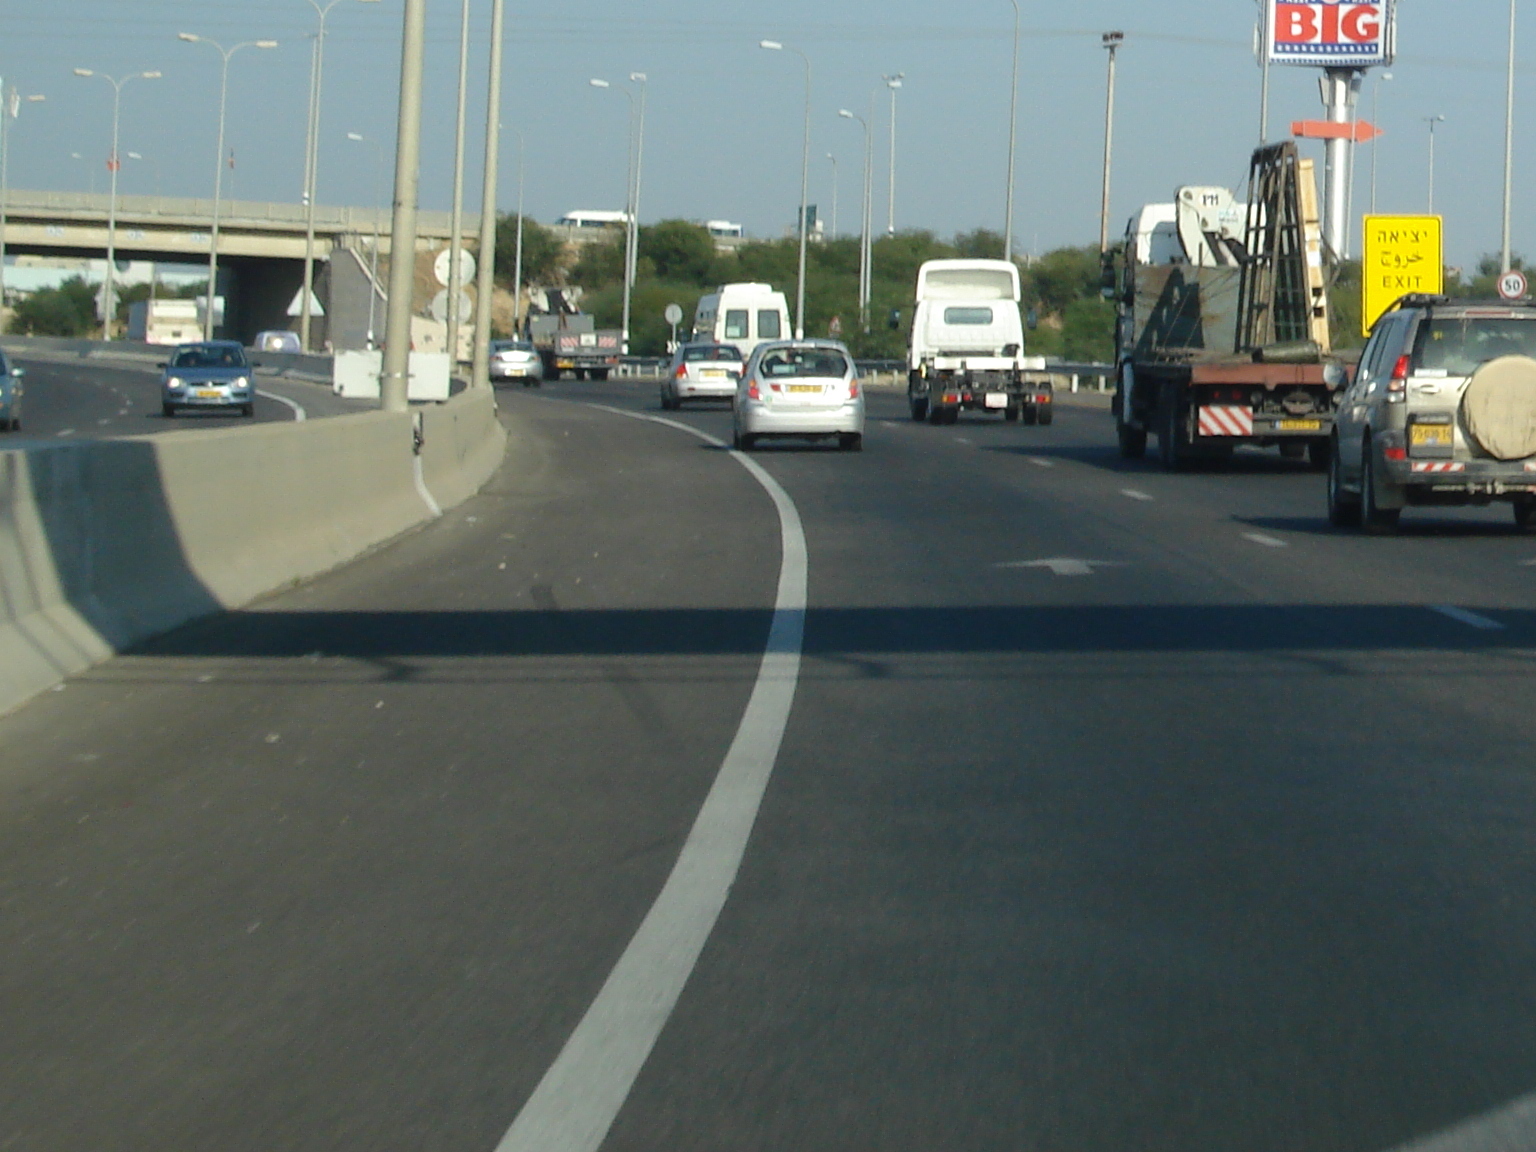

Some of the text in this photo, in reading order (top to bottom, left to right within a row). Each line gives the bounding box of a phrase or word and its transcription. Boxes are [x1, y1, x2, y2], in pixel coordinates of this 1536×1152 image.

[1275, 4, 1380, 44] BIG
[1377, 230, 1428, 243] יציאה
[1380, 250, 1424, 268] خروج
[1382, 275, 1422, 288] EXIT
[1505, 279, 1520, 292] 50
